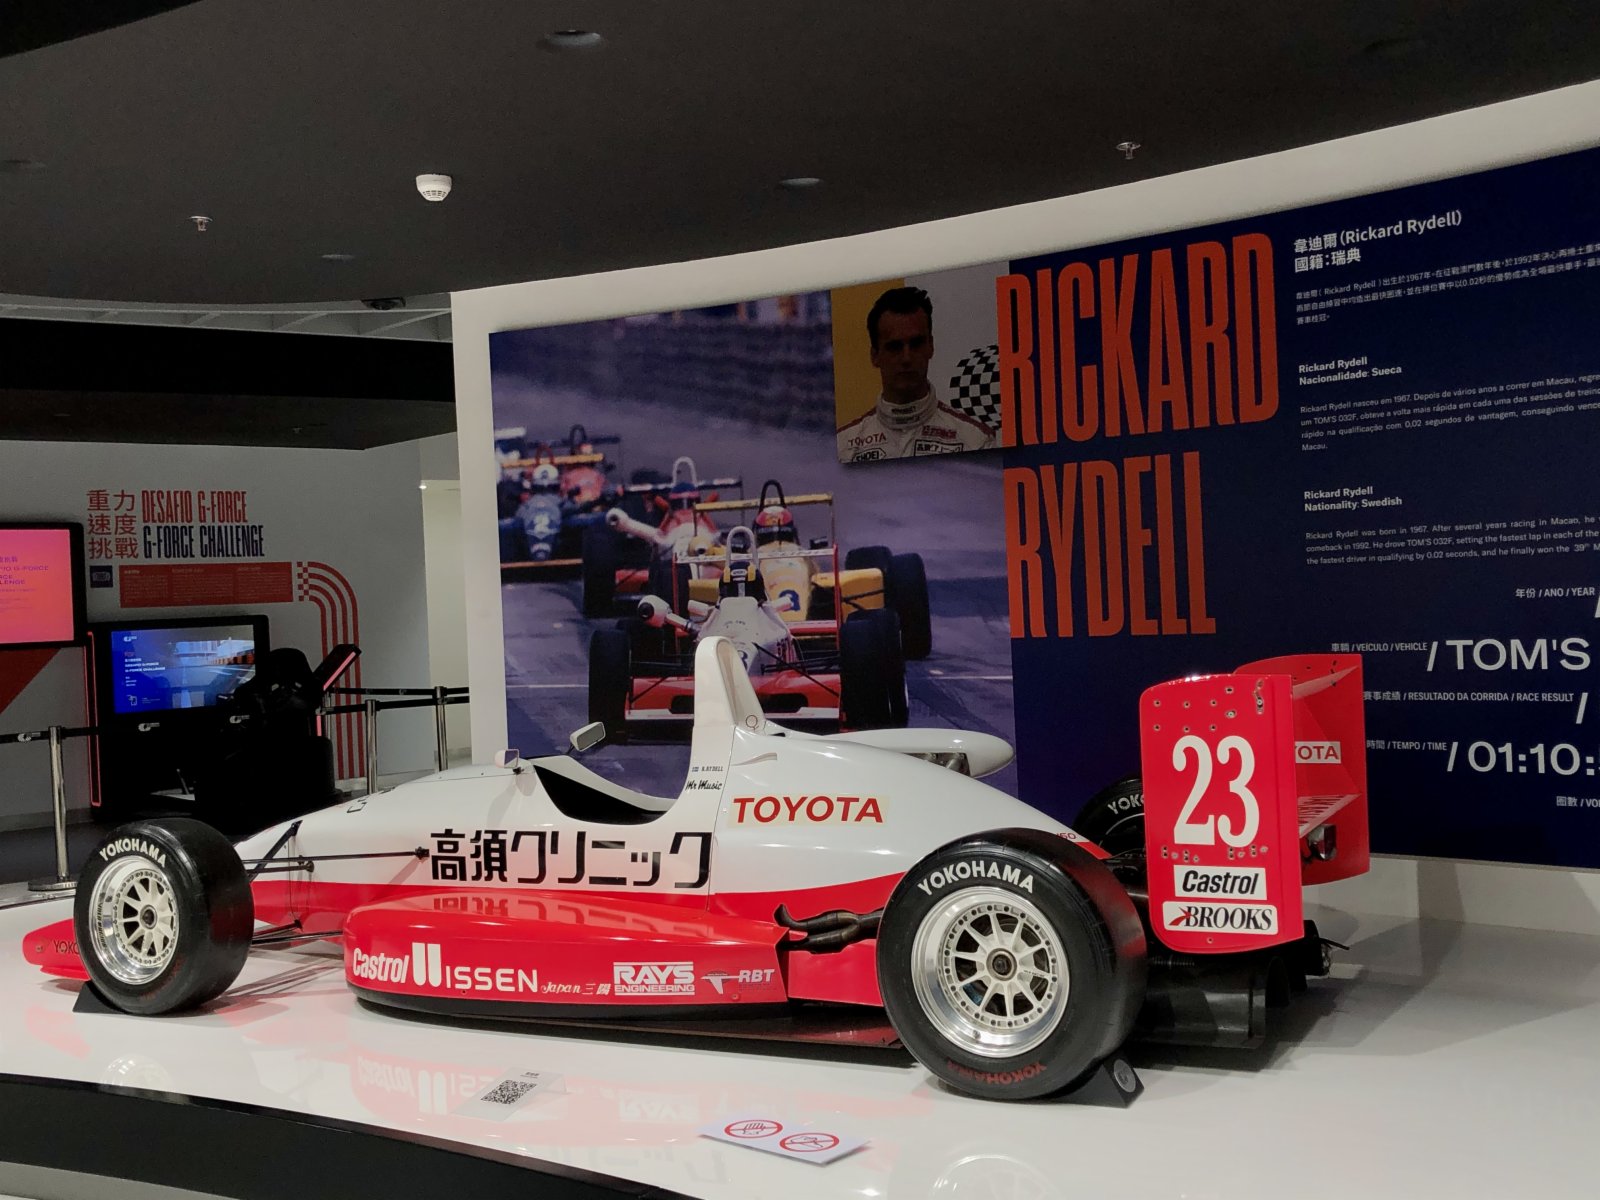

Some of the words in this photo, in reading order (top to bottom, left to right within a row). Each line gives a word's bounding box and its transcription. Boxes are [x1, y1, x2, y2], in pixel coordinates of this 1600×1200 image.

[1407, 210, 1462, 234] Rydell)
[996, 234, 1278, 447] RICKARD
[1299, 361, 1334, 374] Rickard
[1338, 356, 1368, 372] Rydell
[1300, 371, 1370, 386] Nacionalidade:
[1372, 366, 1402, 378] Sueca
[1300, 404, 1327, 414] Rickard
[1329, 402, 1352, 412] Rydell
[1352, 399, 1379, 408] nasceu
[1414, 392, 1440, 402] Depois
[1442, 390, 1452, 398] de
[1454, 387, 1476, 396] vários
[1478, 386, 1498, 394] anos
[1506, 382, 1530, 391] correr
[1532, 380, 1544, 388] em
[1546, 376, 1576, 386] Macau,
[1360, 411, 1384, 420] obteve
[1392, 406, 1411, 416] volta
[1413, 404, 1431, 414] mais
[1432, 402, 1457, 414] rápida
[1459, 401, 1471, 410] em
[1472, 398, 1492, 408] cada
[1494, 397, 1511, 406] uma
[1513, 394, 1528, 404] das
[1530, 391, 1562, 402] sessões
[1565, 390, 1576, 398] de
[1301, 430, 1324, 440] rápido
[1386, 422, 1402, 430] com
[1425, 416, 1462, 428] segundos
[1465, 414, 1474, 422] de
[1522, 404, 1574, 416] conseguindo
[848, 432, 886, 446] TOYOTA
[86, 490, 134, 512] 重力
[1304, 489, 1340, 500] Rickard
[1343, 486, 1373, 498] Rydell
[1304, 500, 1360, 512] Nationality:
[1361, 496, 1402, 508] Swedish
[142, 490, 192, 524] DESAFIO
[198, 491, 248, 523] G-FORCE
[88, 514, 136, 536] 速度
[1306, 531, 1332, 540] Rickard
[1336, 530, 1358, 540] Rydell
[1380, 526, 1396, 536] born
[1400, 526, 1407, 534] in
[1432, 524, 1452, 532] After
[1454, 522, 1482, 531] several
[1486, 521, 1507, 530] years
[1510, 520, 1536, 529] racing
[1539, 518, 1547, 526] in
[1584, 514, 1596, 524] he
[88, 538, 139, 560] 挑戰
[143, 526, 195, 558] G-FORCE
[200, 525, 264, 558] CHALLENGE
[1003, 452, 1216, 638] RYDELL
[1306, 542, 1342, 552] comeback
[1344, 542, 1351, 550] in
[1373, 540, 1384, 549] He
[1384, 539, 1405, 548] drove
[1406, 538, 1432, 546] TOM'S
[1456, 535, 1483, 545] setting
[1485, 534, 1497, 543] the
[1499, 532, 1527, 542] fastest
[1528, 532, 1542, 542] lap
[1544, 531, 1551, 540] in
[1552, 530, 1573, 539] each
[1574, 530, 1584, 538] of
[1585, 529, 1600, 538] the
[1306, 556, 1318, 565] the
[1320, 555, 1344, 564] fastest
[1346, 554, 1366, 563] driver
[1368, 554, 1376, 562] in
[1378, 552, 1414, 562] qualifying
[1416, 552, 1424, 560] by
[1426, 550, 1444, 559] 0.02
[1446, 549, 1480, 558] seconds,
[1482, 548, 1496, 556] and
[1498, 548, 1508, 556] he
[1510, 546, 1535, 556] finally
[1556, 544, 1570, 553] the
[1516, 588, 1536, 598] 年份
[1544, 588, 1564, 597] ANO
[1572, 587, 1595, 596] YEAR
[1395, 642, 1428, 651] VEHICLE
[1446, 638, 1591, 671] TOM'S
[1408, 692, 1456, 701] RESULTADO
[1457, 692, 1468, 701] DA
[1470, 692, 1509, 701] CORRIDA
[1516, 692, 1539, 702] RACE
[1542, 693, 1574, 702] RESULT
[1294, 745, 1339, 760] OTA
[1392, 741, 1420, 750] TEMPO
[1427, 742, 1448, 750] TIME
[1468, 741, 1600, 776] 01:10:
[1172, 735, 1260, 848] 23
[733, 796, 883, 824] TOYOTA
[100, 838, 167, 869] YOKOHAMA
[430, 829, 712, 889] 高須クリニック
[917, 860, 1034, 896] YOKOHAMA
[1182, 870, 1258, 896] Castrol
[1184, 905, 1272, 930] BROOKS
[353, 947, 410, 984] Castrol
[614, 966, 694, 985] RAYS
[738, 969, 775, 982] RBT
[540, 982, 581, 994] Japan
[615, 984, 694, 993] ENGINEERING
